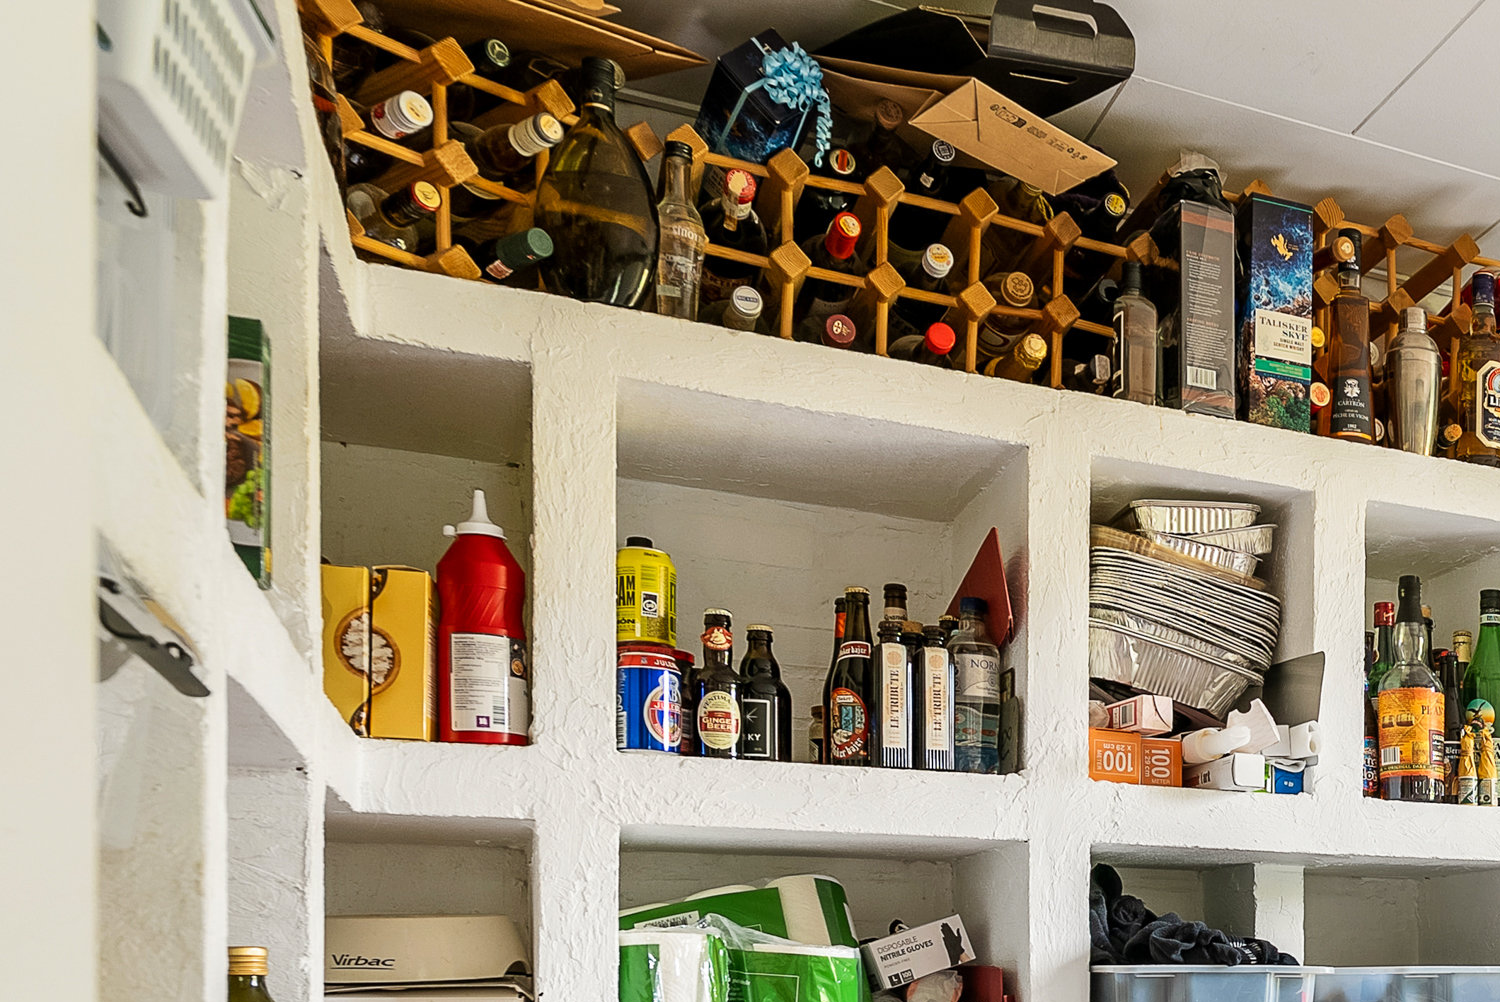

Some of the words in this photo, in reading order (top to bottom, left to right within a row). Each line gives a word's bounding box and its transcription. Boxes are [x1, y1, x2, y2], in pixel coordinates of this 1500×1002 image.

[1260, 316, 1308, 333] TALISKER
[1282, 330, 1308, 341] SKYE
[1103, 750, 1134, 773] 100
[1151, 748, 1171, 778] 100
[877, 935, 917, 954] DISPOSABLE
[880, 946, 906, 962] NITRILE
[907, 940, 934, 953] GLOVES
[331, 954, 396, 967] Virbac
